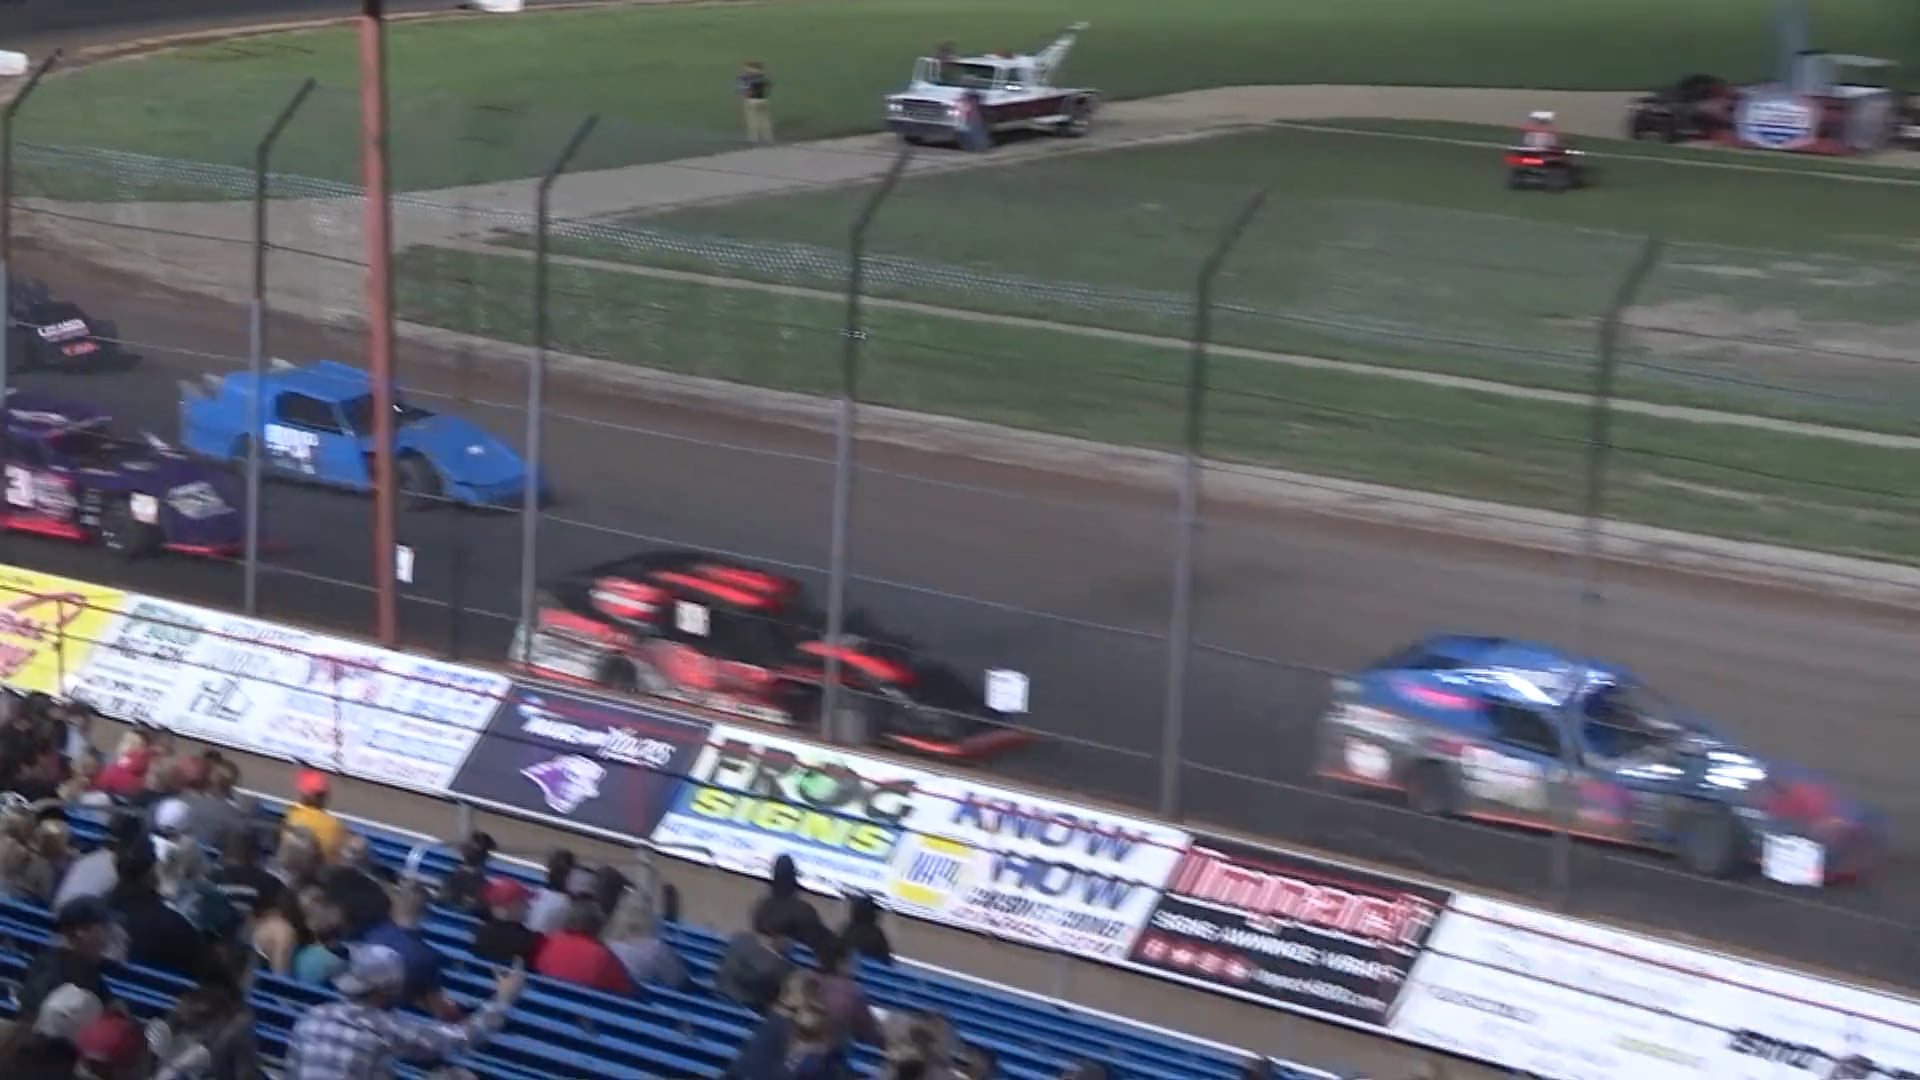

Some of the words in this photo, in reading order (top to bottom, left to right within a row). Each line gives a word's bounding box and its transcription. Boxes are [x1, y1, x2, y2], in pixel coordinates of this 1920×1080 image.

[706, 738, 915, 820] FROG
[689, 786, 897, 857] SIGNS
[951, 792, 1148, 862] KNOW
[990, 850, 1144, 909] HOW
